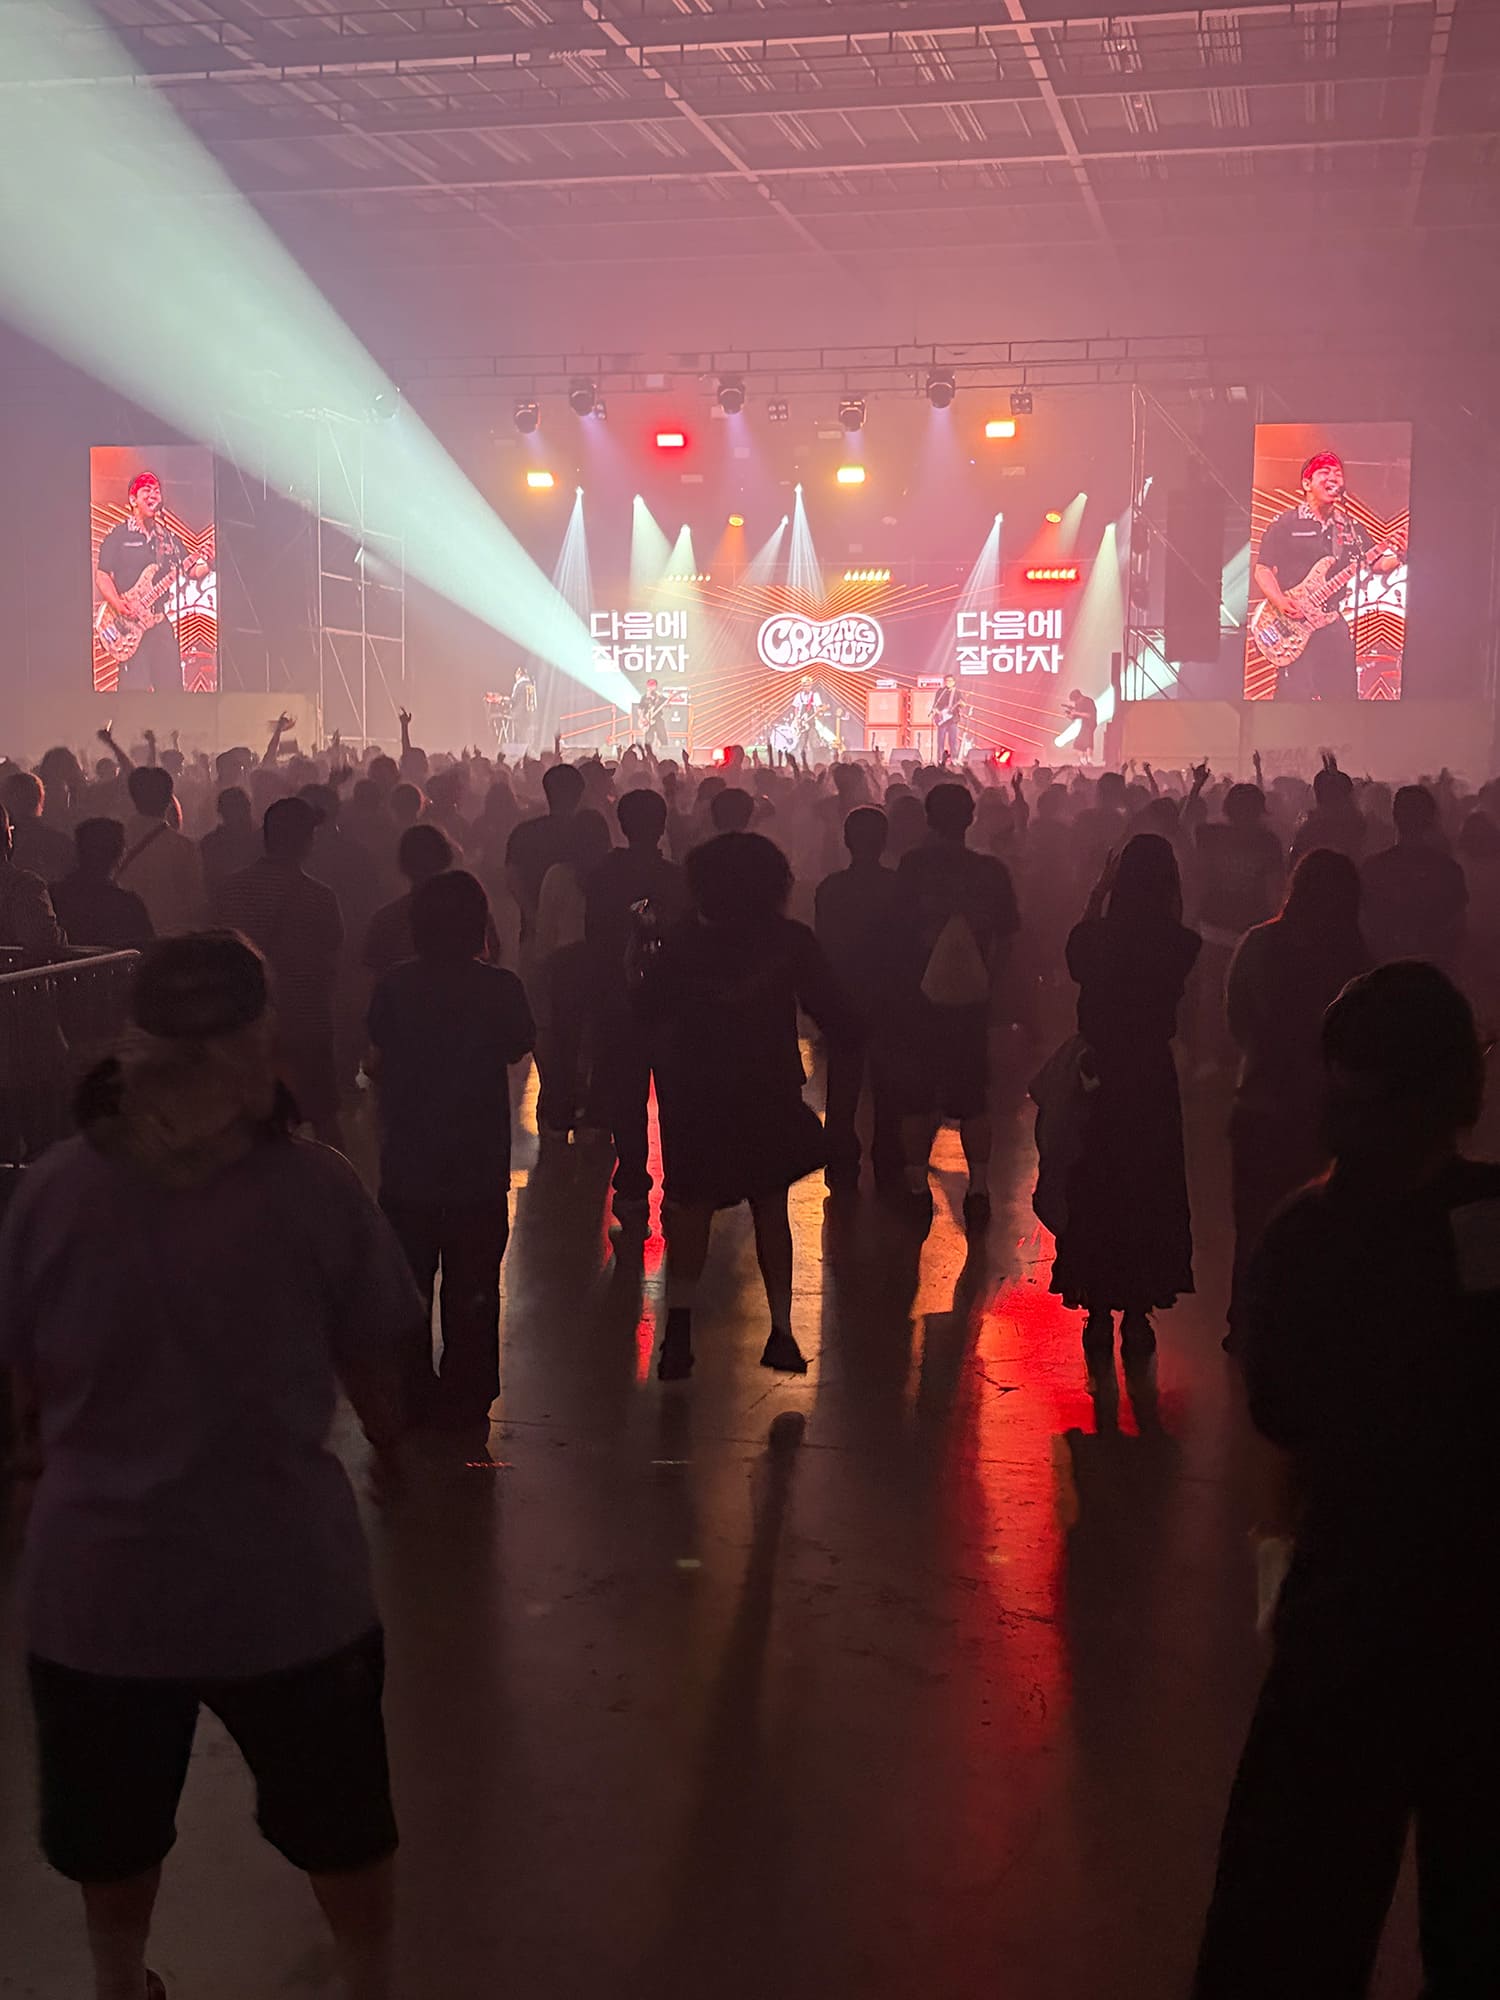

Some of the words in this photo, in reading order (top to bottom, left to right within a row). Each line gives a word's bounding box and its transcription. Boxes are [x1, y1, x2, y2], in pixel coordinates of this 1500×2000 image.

[590, 609, 687, 640] 다음에
[956, 609, 1062, 640] 다음에
[763, 619, 877, 664] CRYING
[816, 641, 876, 664] NUT
[956, 644, 1064, 675] 잘하자
